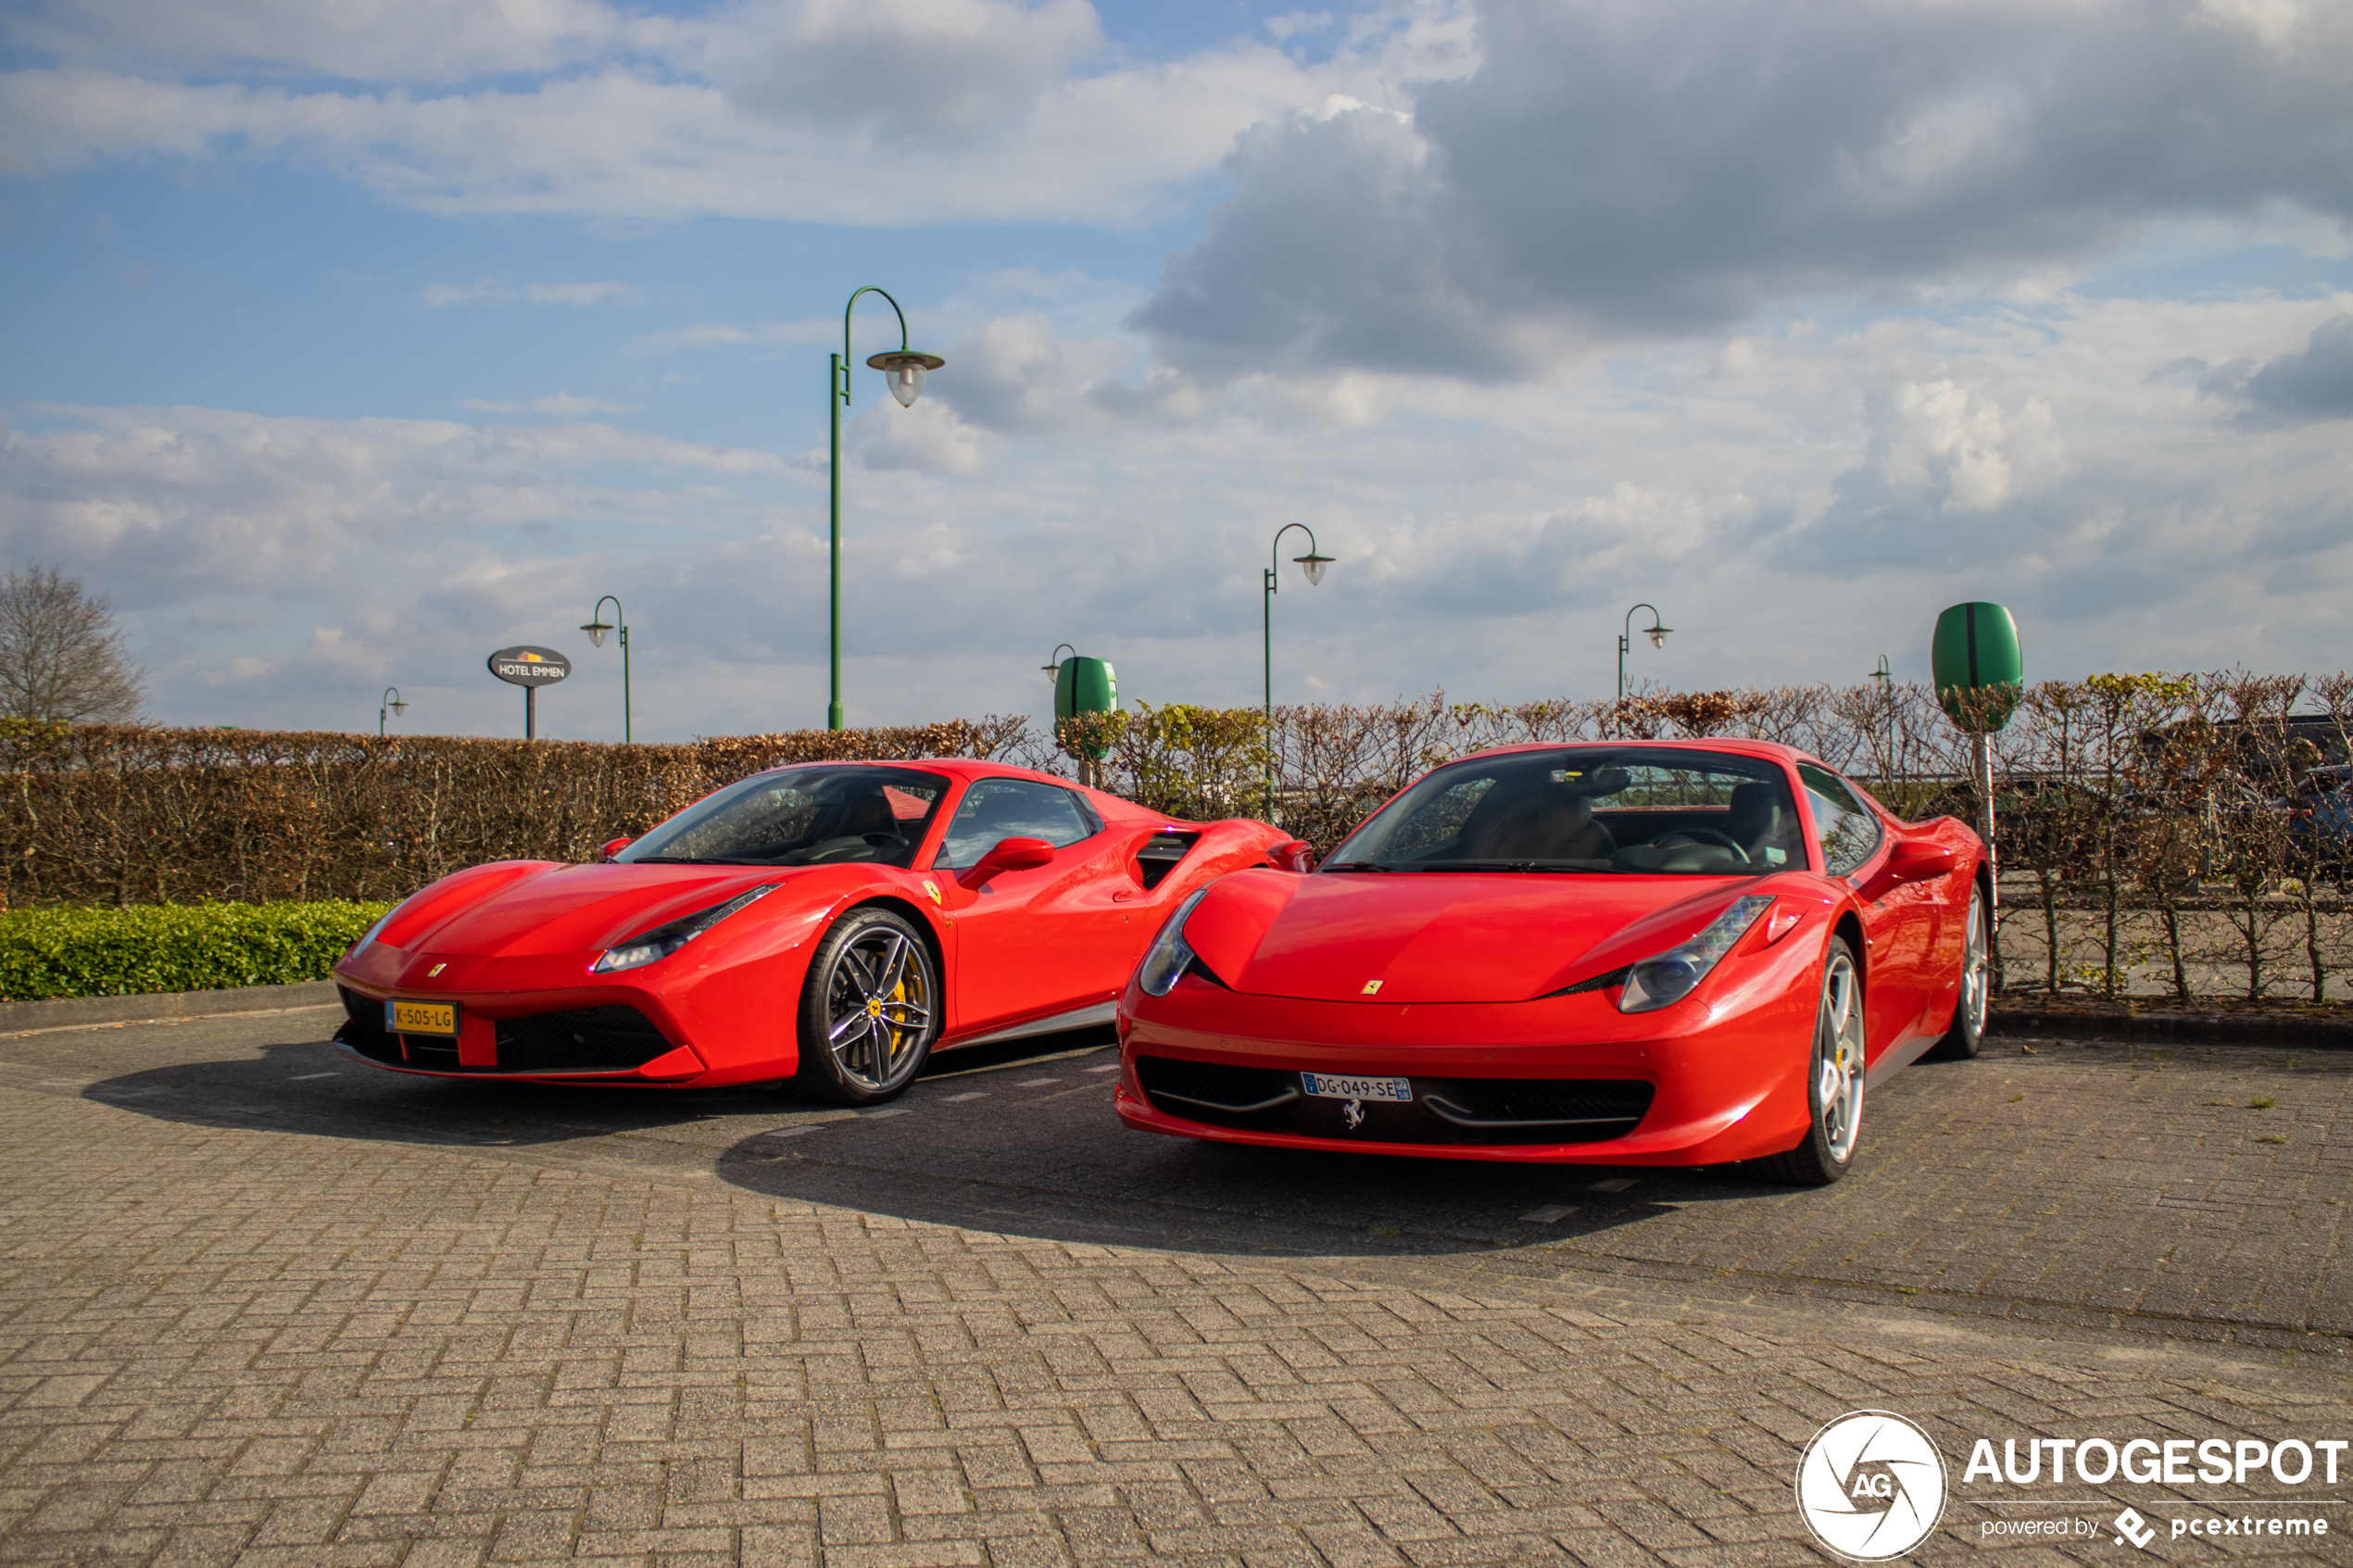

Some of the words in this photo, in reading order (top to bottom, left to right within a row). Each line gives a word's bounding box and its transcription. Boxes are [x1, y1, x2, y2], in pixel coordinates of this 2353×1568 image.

[498, 664, 531, 676] HOTEL
[532, 666, 565, 678] EMMEN
[396, 1008, 451, 1026] K-505-LG
[1316, 1077, 1396, 1097] DG-049-SE
[1397, 1091, 1410, 1099] 58
